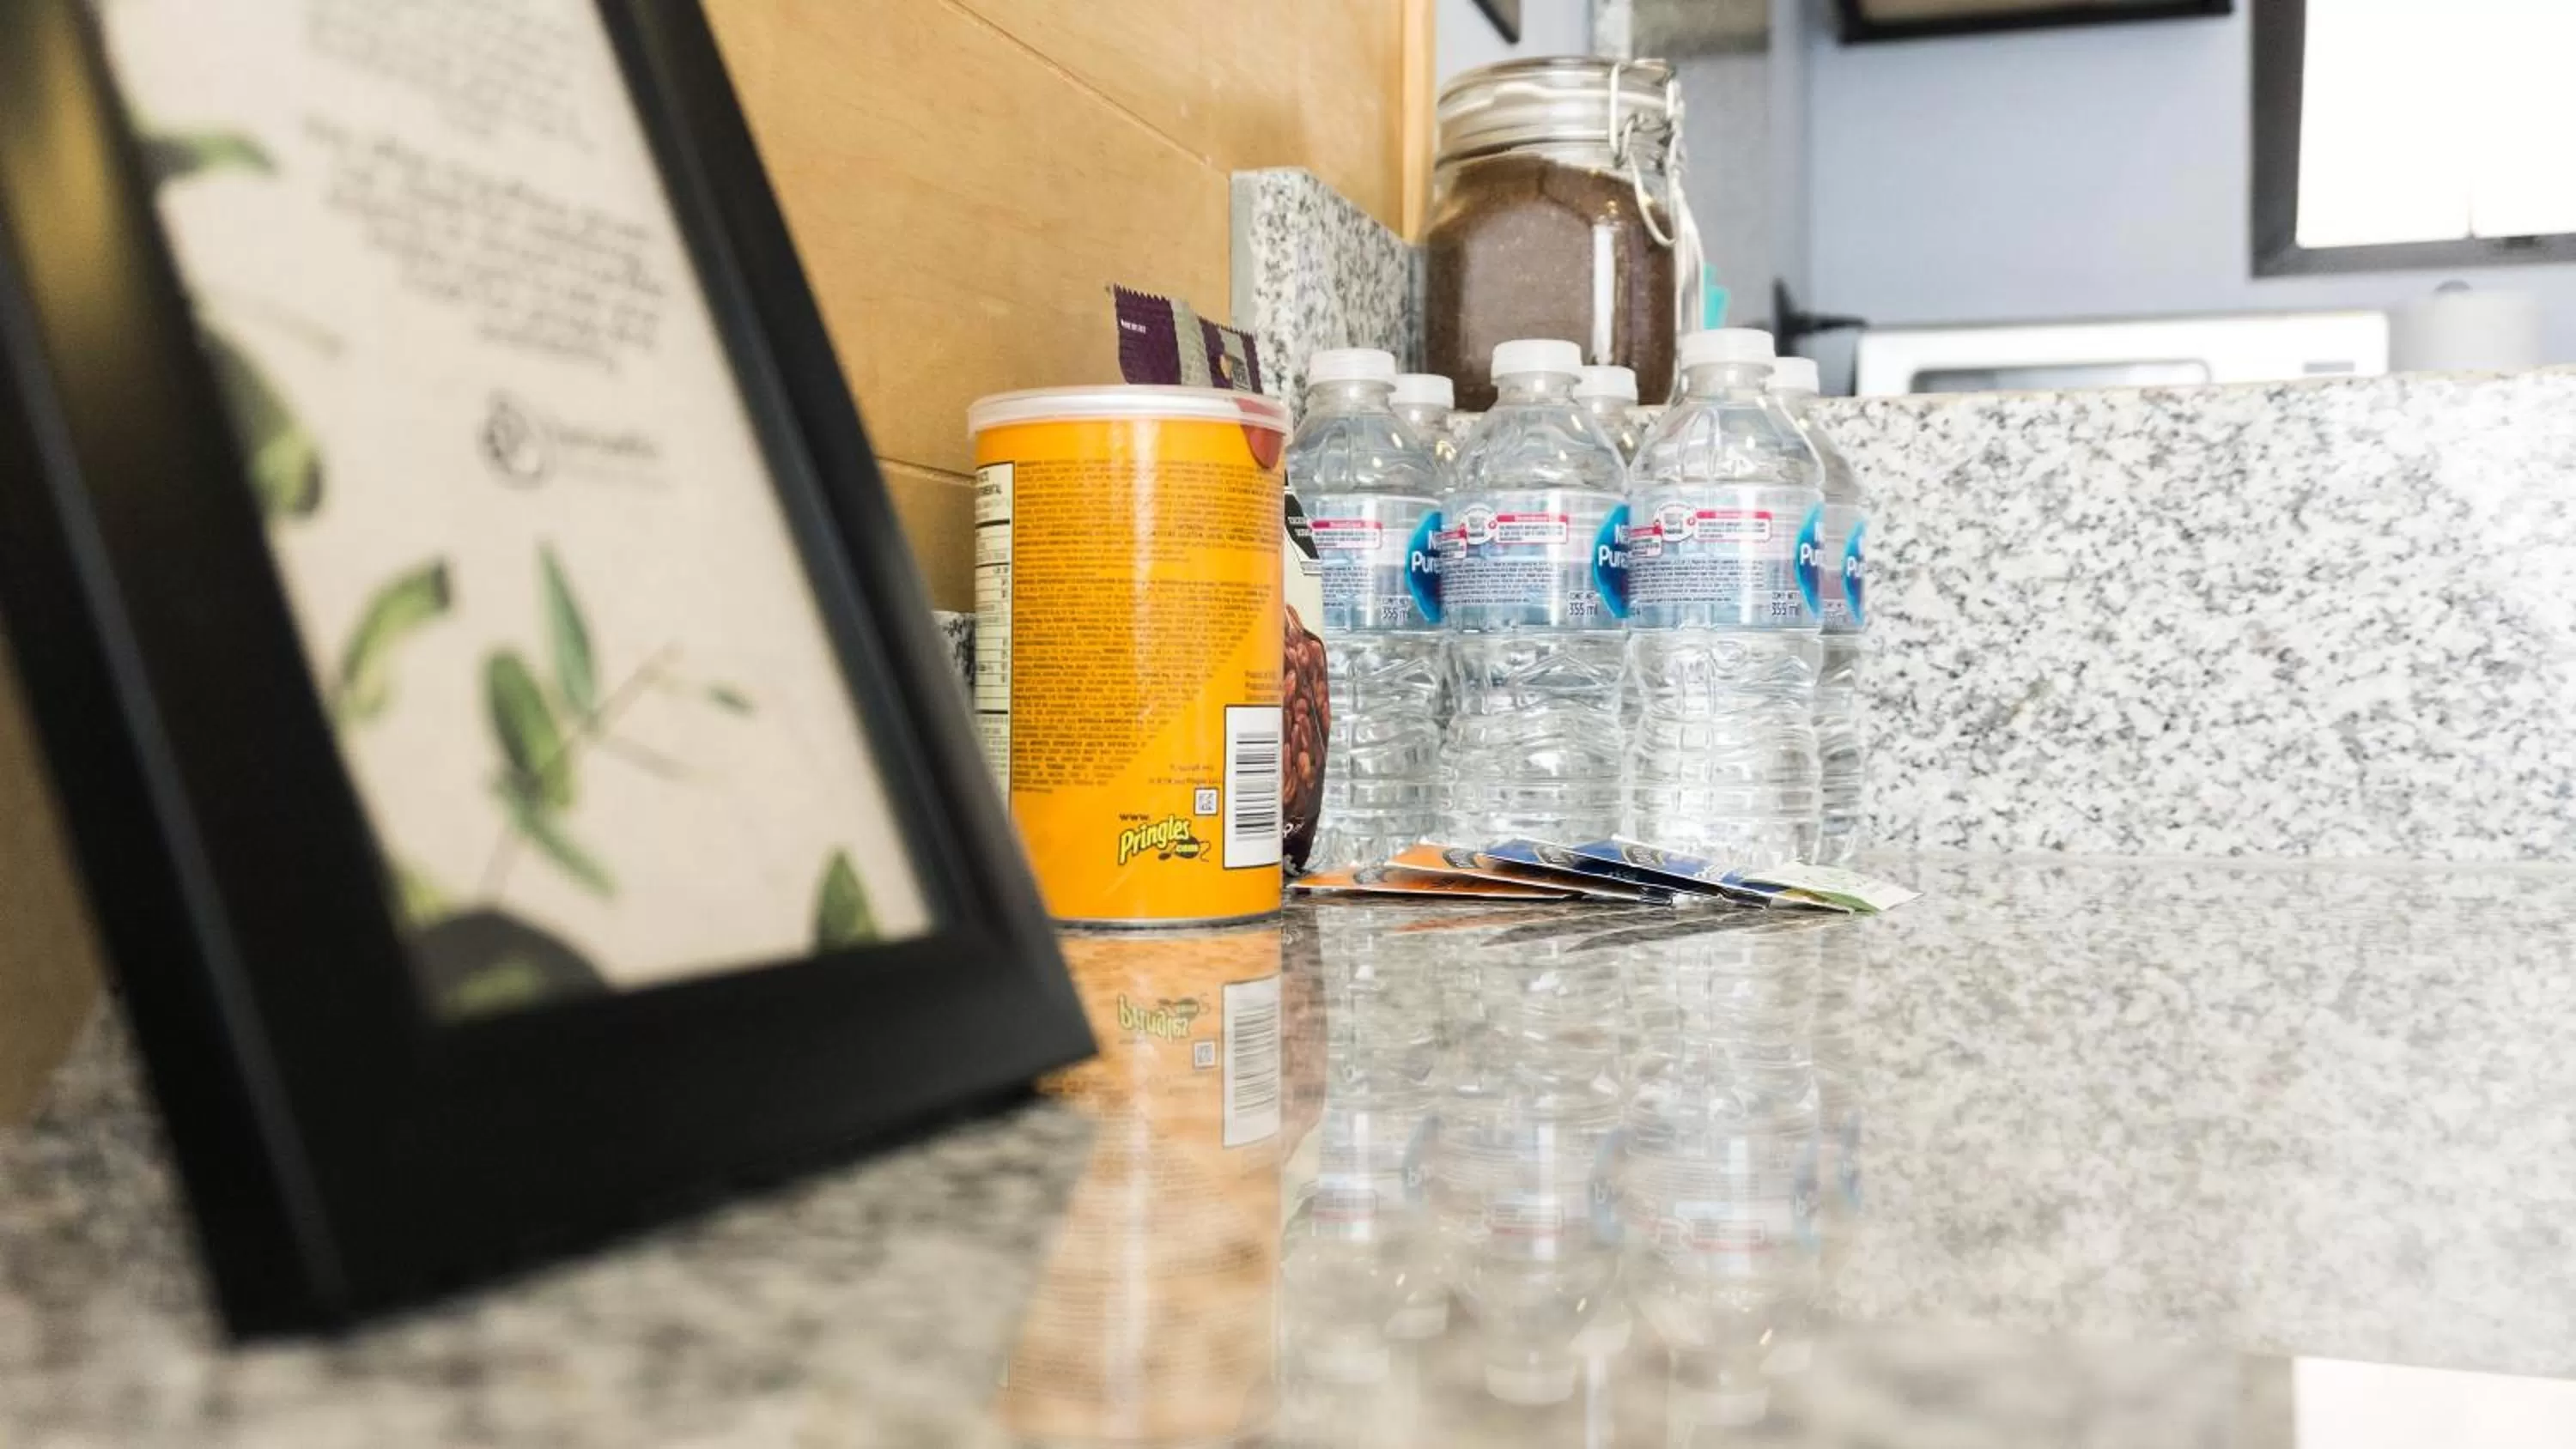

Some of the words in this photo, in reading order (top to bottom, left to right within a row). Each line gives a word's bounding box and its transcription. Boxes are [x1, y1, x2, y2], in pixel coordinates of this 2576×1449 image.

[1569, 603, 1584, 615] 355
[1771, 603, 1786, 615] 355
[1118, 814, 1191, 865] Pringles
